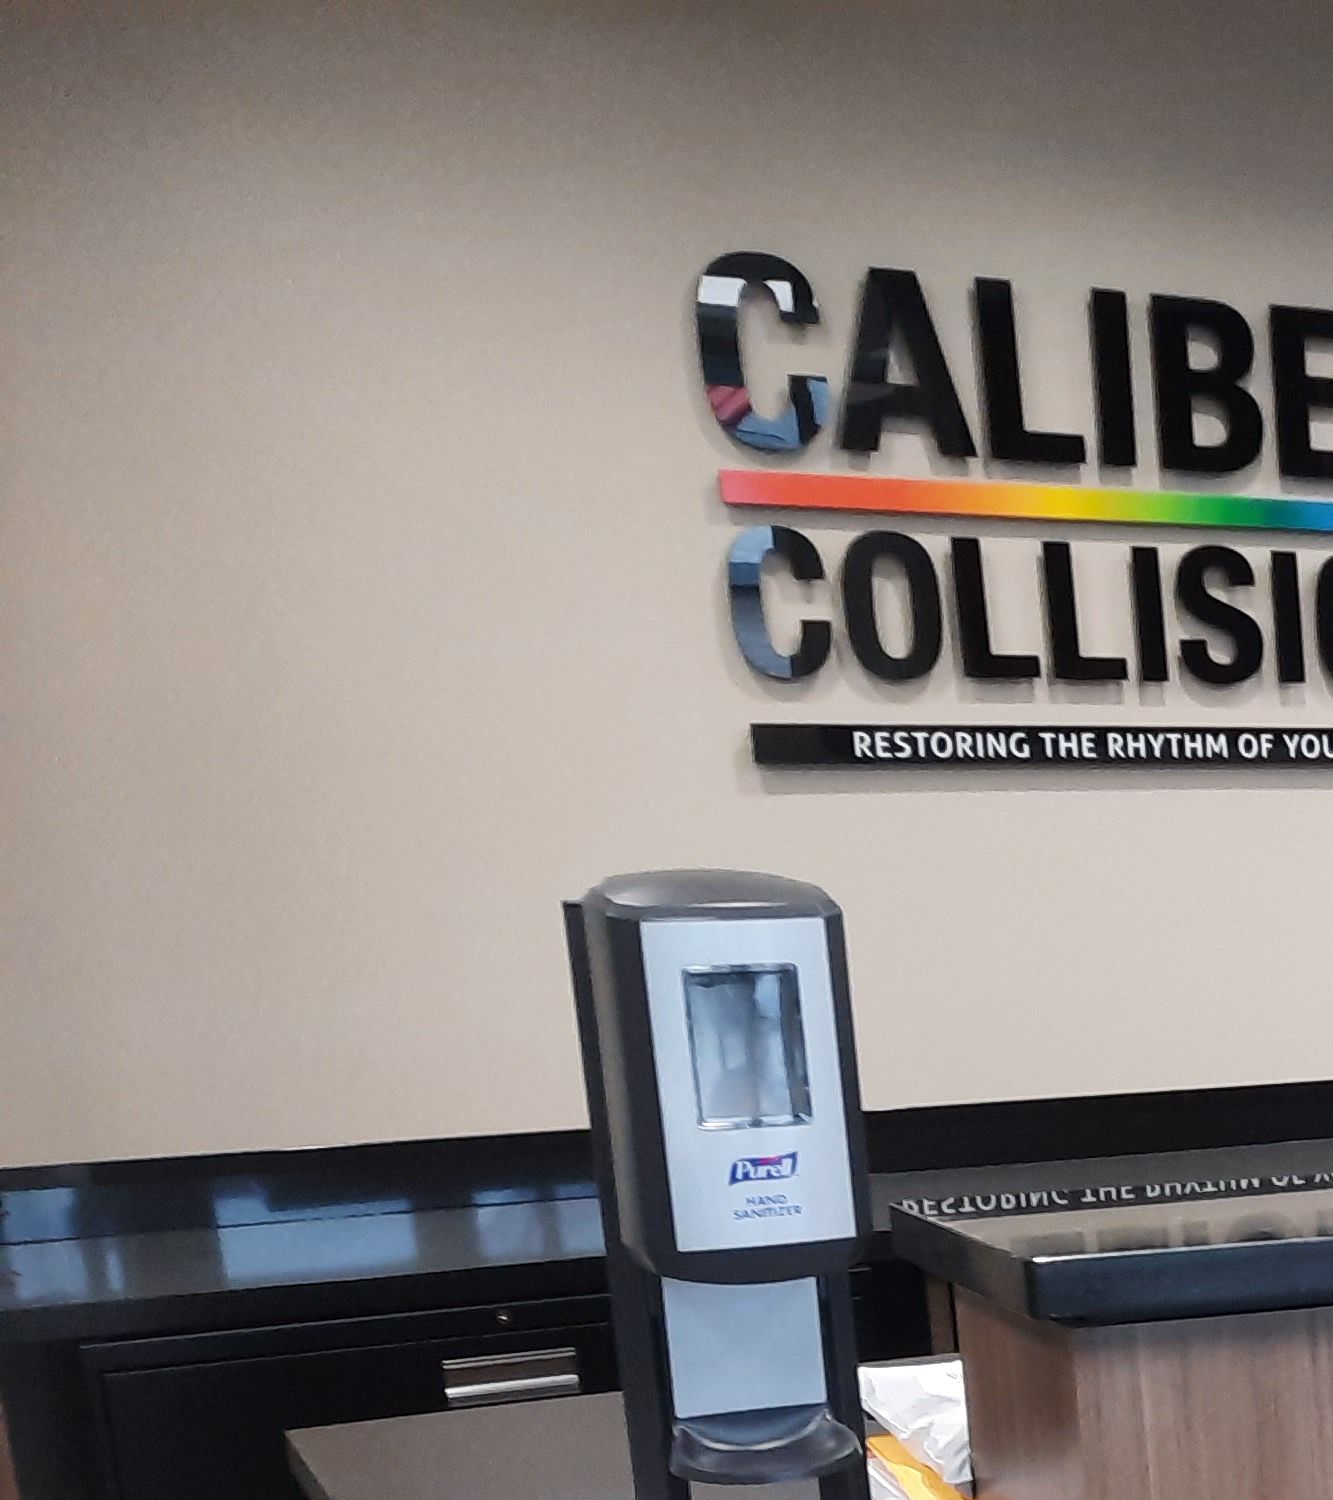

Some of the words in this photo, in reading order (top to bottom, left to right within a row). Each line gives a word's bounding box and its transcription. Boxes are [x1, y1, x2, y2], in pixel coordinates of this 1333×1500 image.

[853, 731, 1030, 759] RESTORING
[1038, 732, 1097, 759] THE
[1107, 733, 1228, 760] RHYTHM
[1237, 734, 1274, 760] OF
